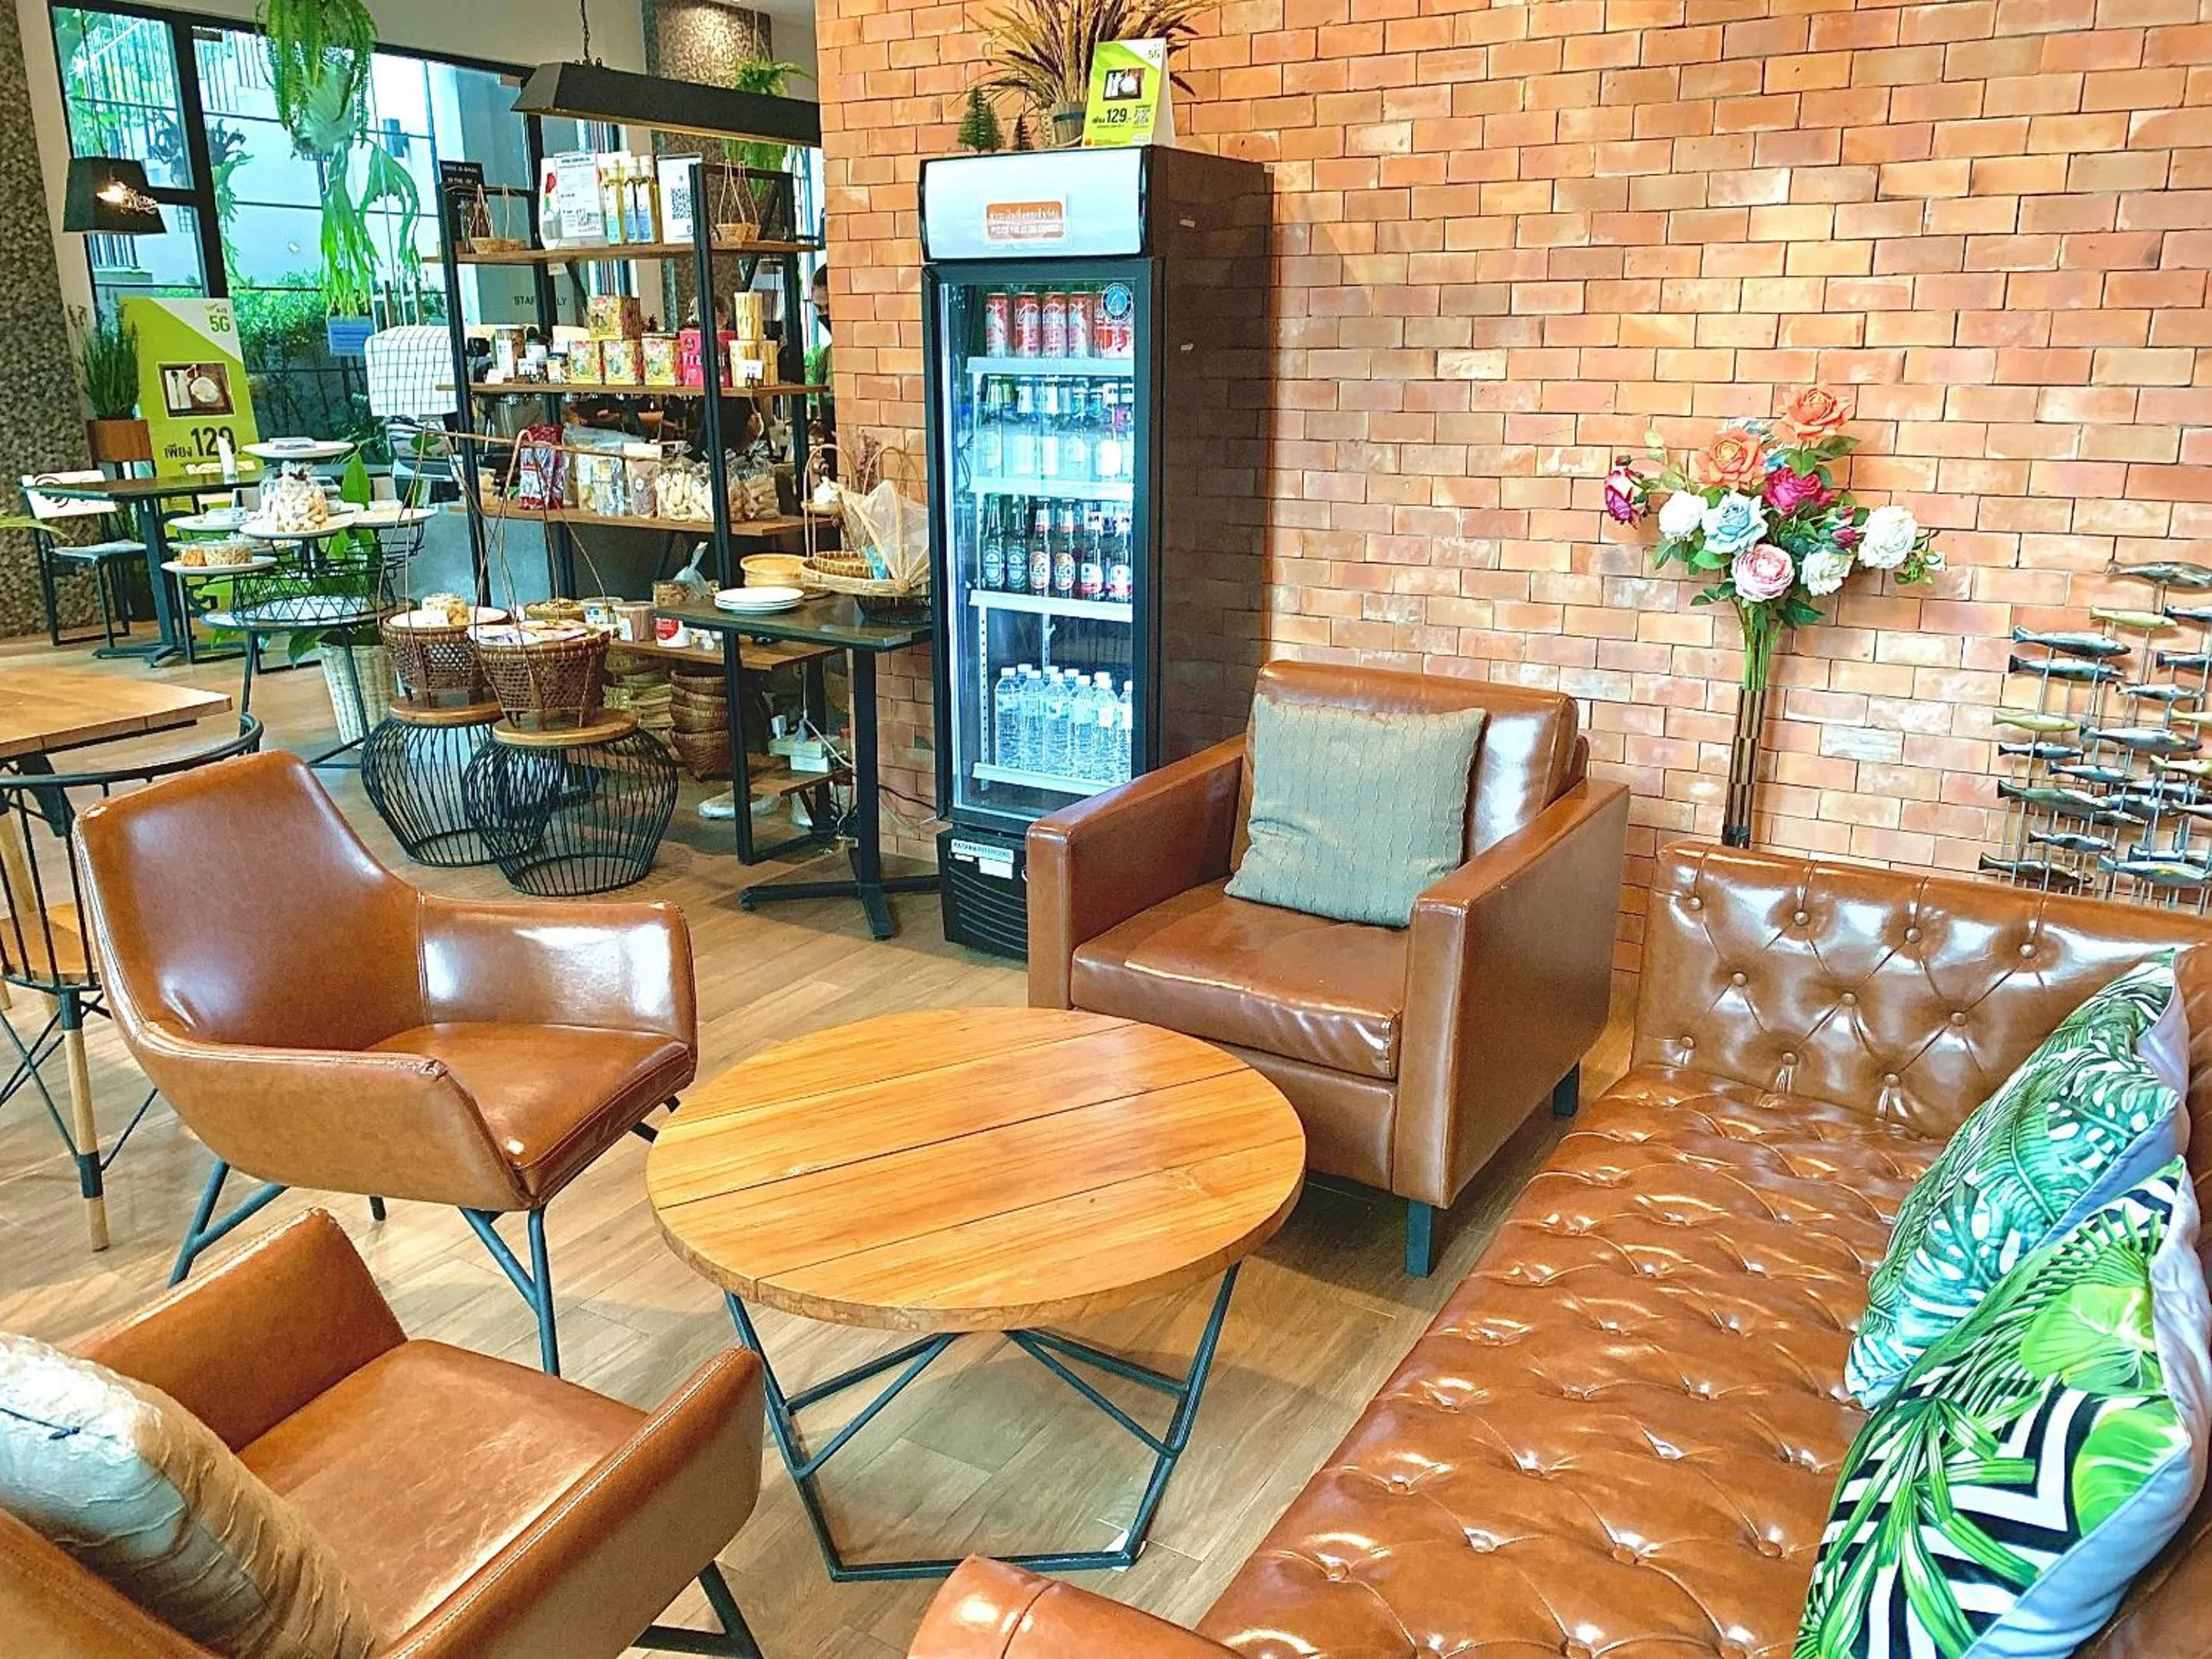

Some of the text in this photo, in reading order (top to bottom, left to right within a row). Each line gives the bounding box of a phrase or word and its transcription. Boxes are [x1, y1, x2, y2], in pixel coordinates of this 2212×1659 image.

[514, 296, 537, 306] STAF
[209, 314, 231, 333] 5G
[164, 443, 193, 459] เพียง
